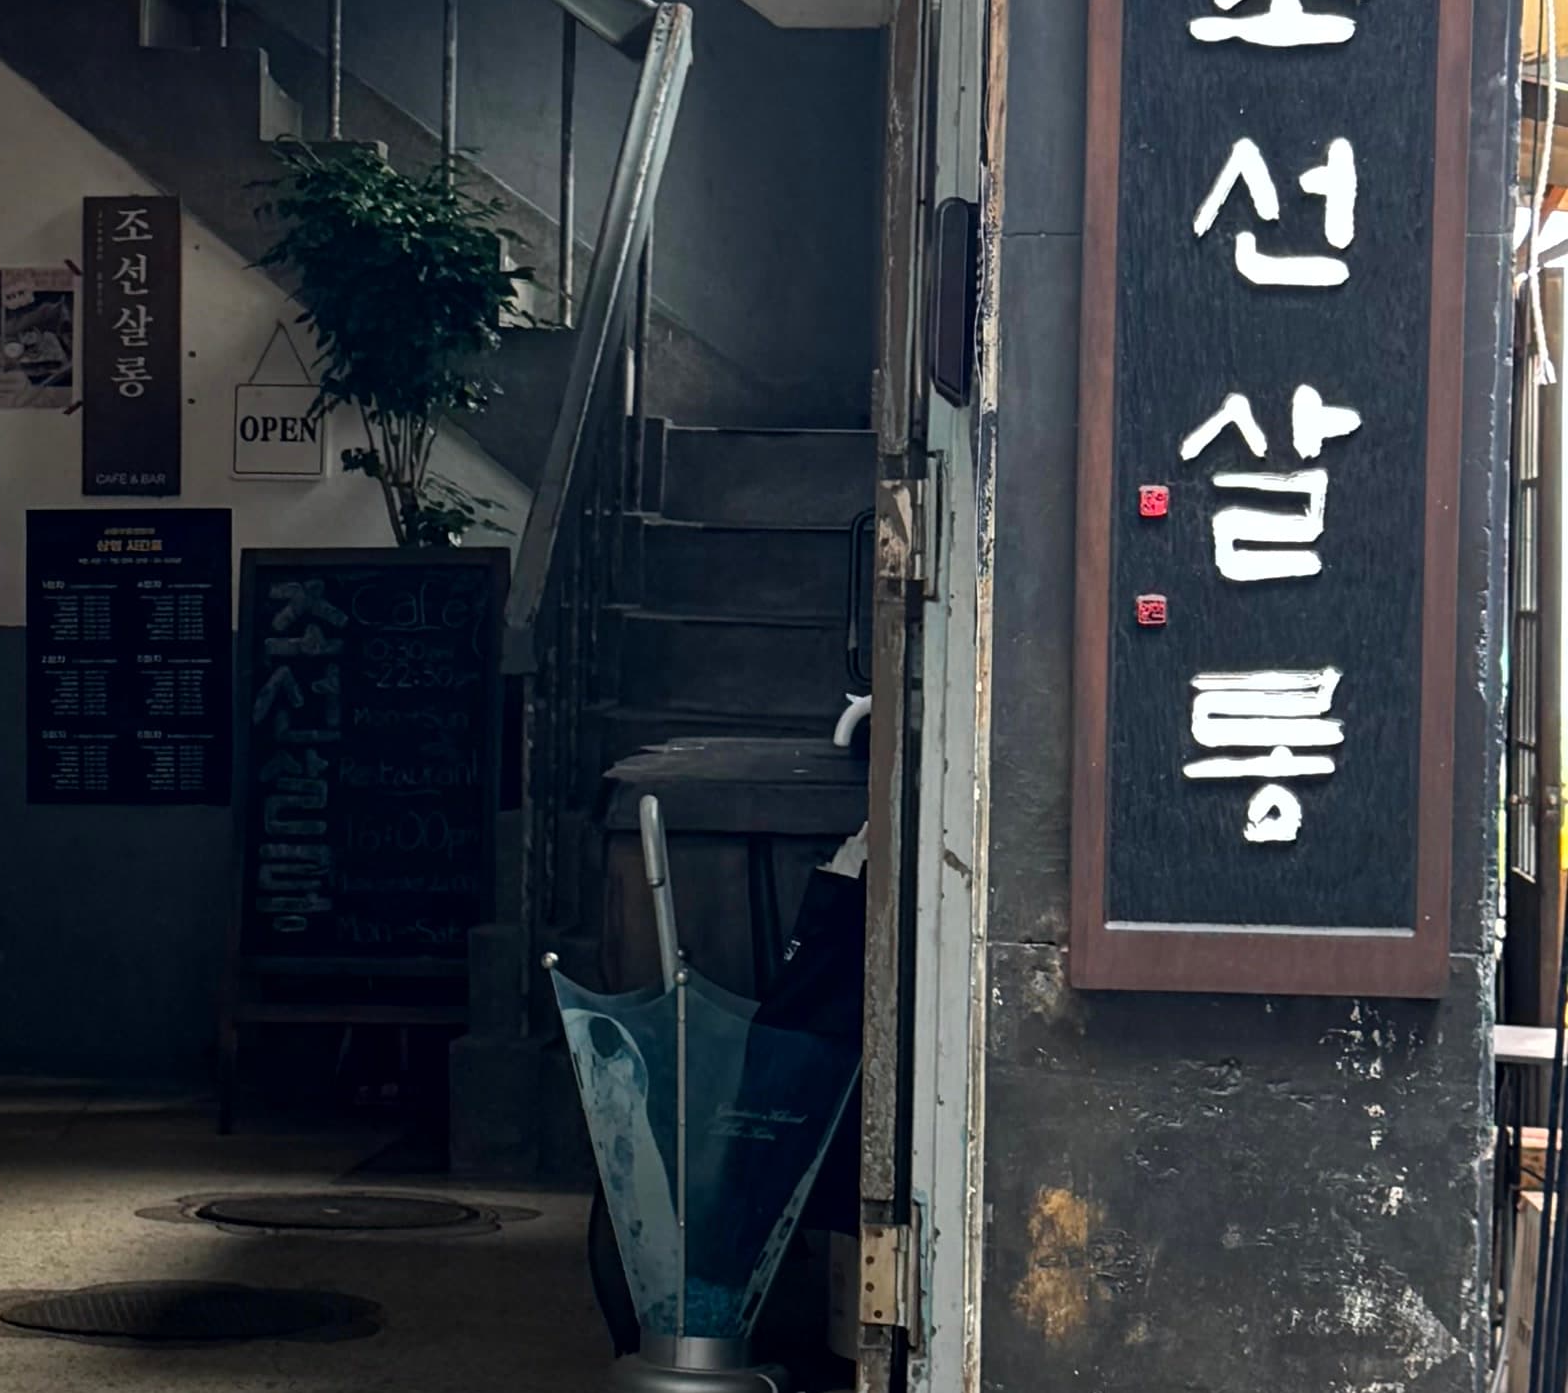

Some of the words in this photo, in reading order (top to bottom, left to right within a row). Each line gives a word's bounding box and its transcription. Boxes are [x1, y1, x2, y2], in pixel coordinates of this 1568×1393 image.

[110, 208, 153, 398] 조선살롱
[239, 414, 320, 444] OPEN
[95, 473, 127, 486] CAFE
[140, 473, 166, 486] BAR
